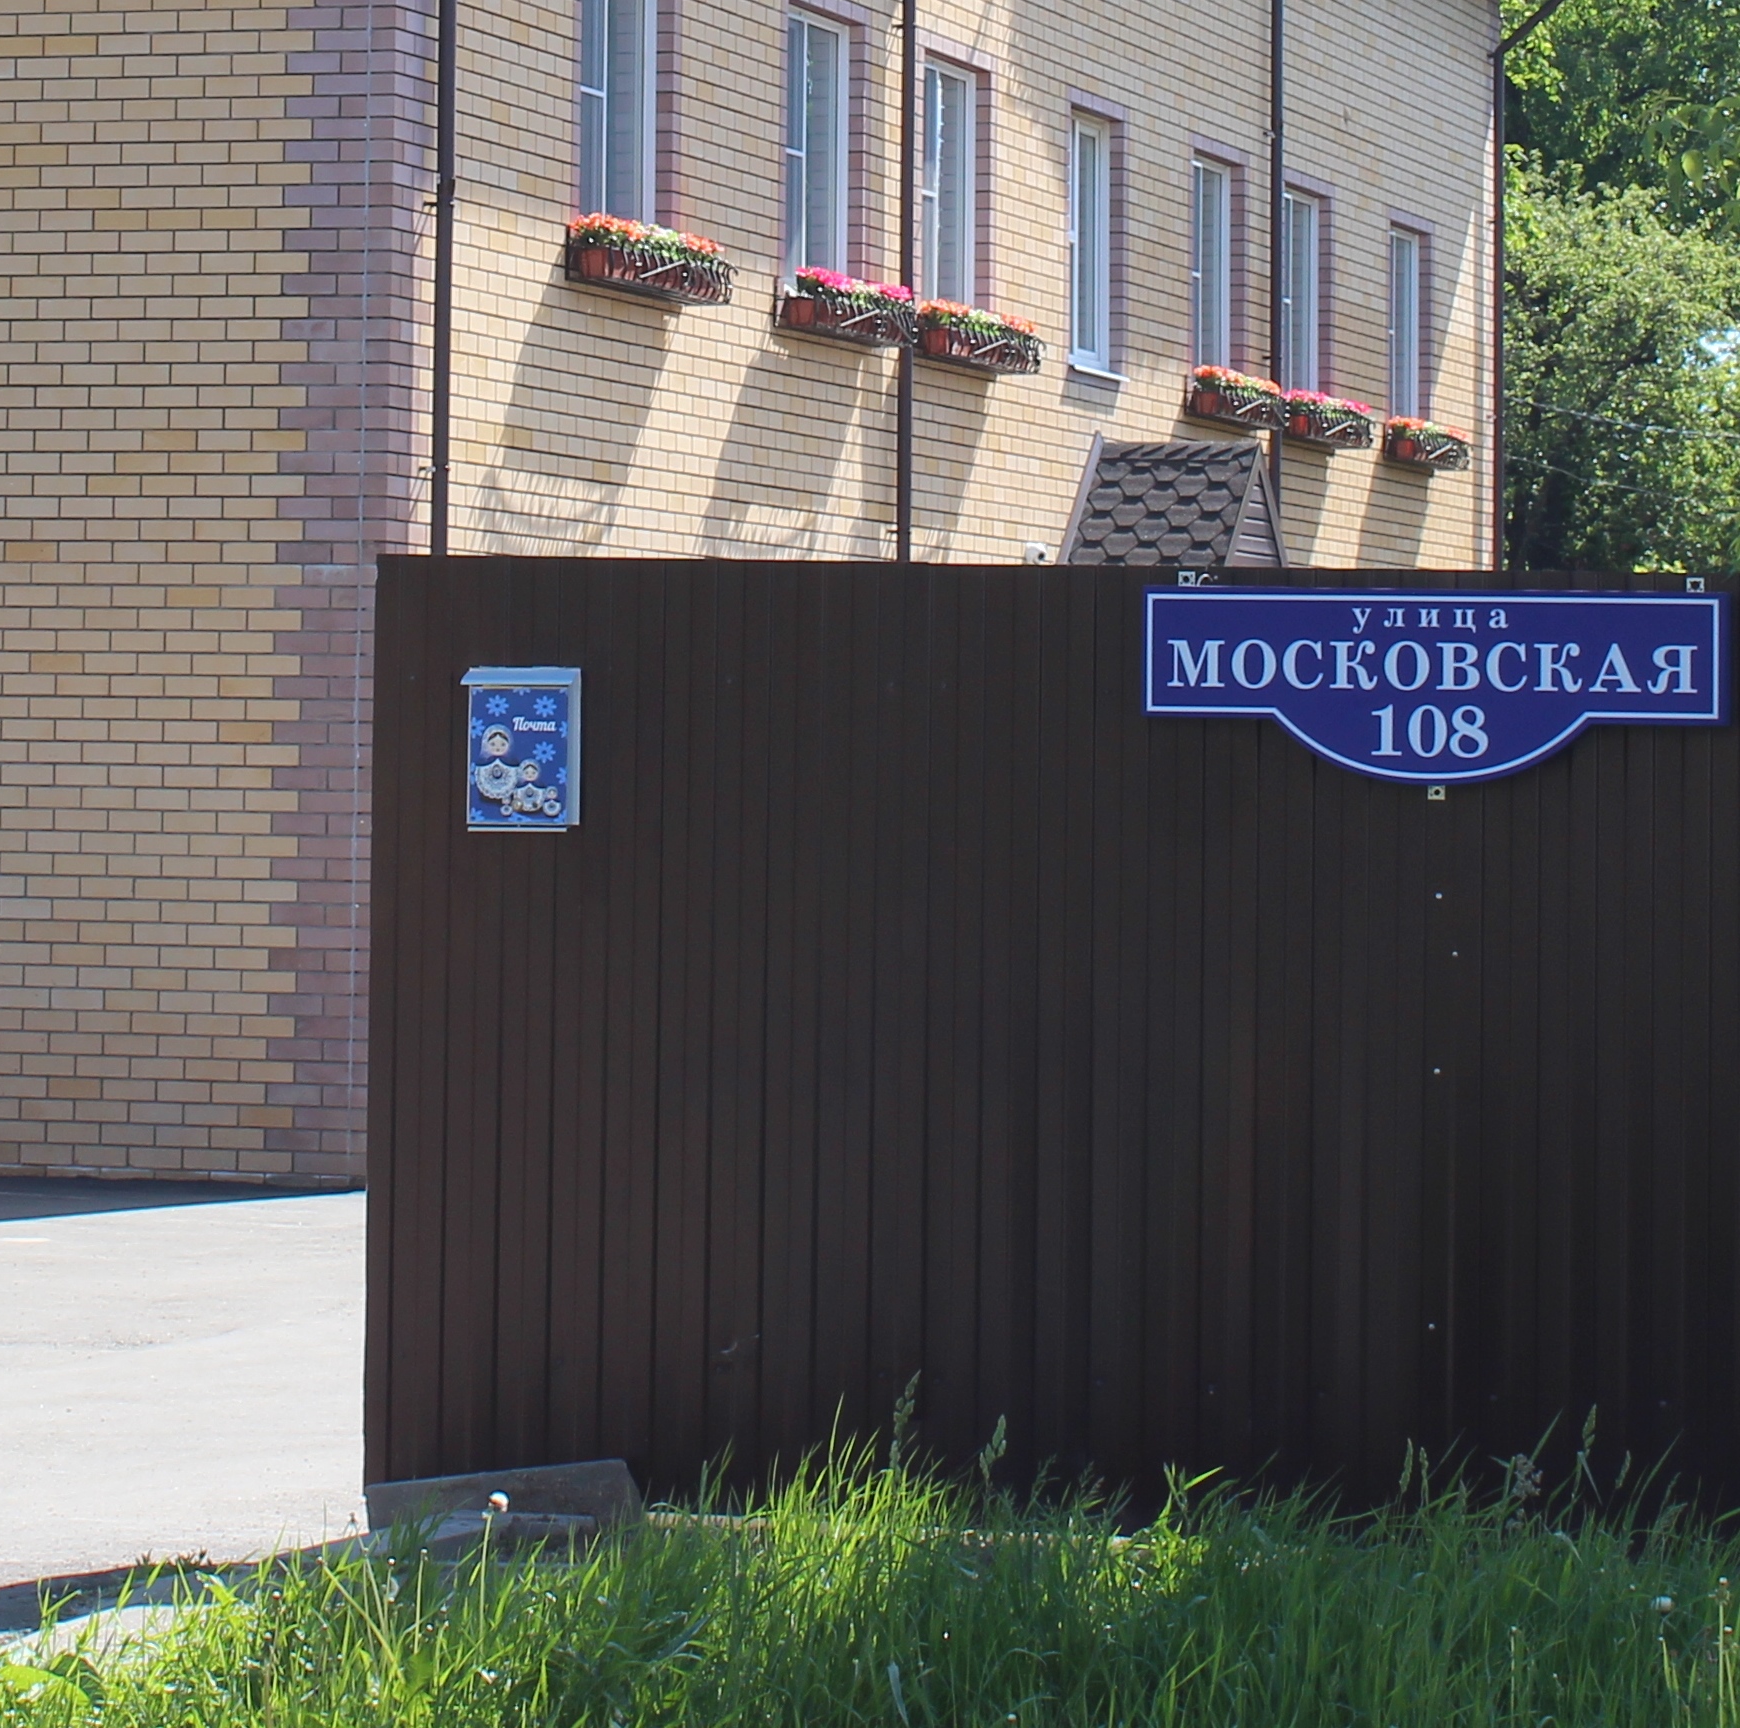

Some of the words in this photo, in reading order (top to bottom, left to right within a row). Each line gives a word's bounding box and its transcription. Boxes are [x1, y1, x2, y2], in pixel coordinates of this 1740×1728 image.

[1352, 607, 1510, 634] улица
[1166, 639, 1698, 695] МОСКОВСКАЯ
[512, 716, 557, 732] Почта
[1371, 704, 1489, 759] 108
